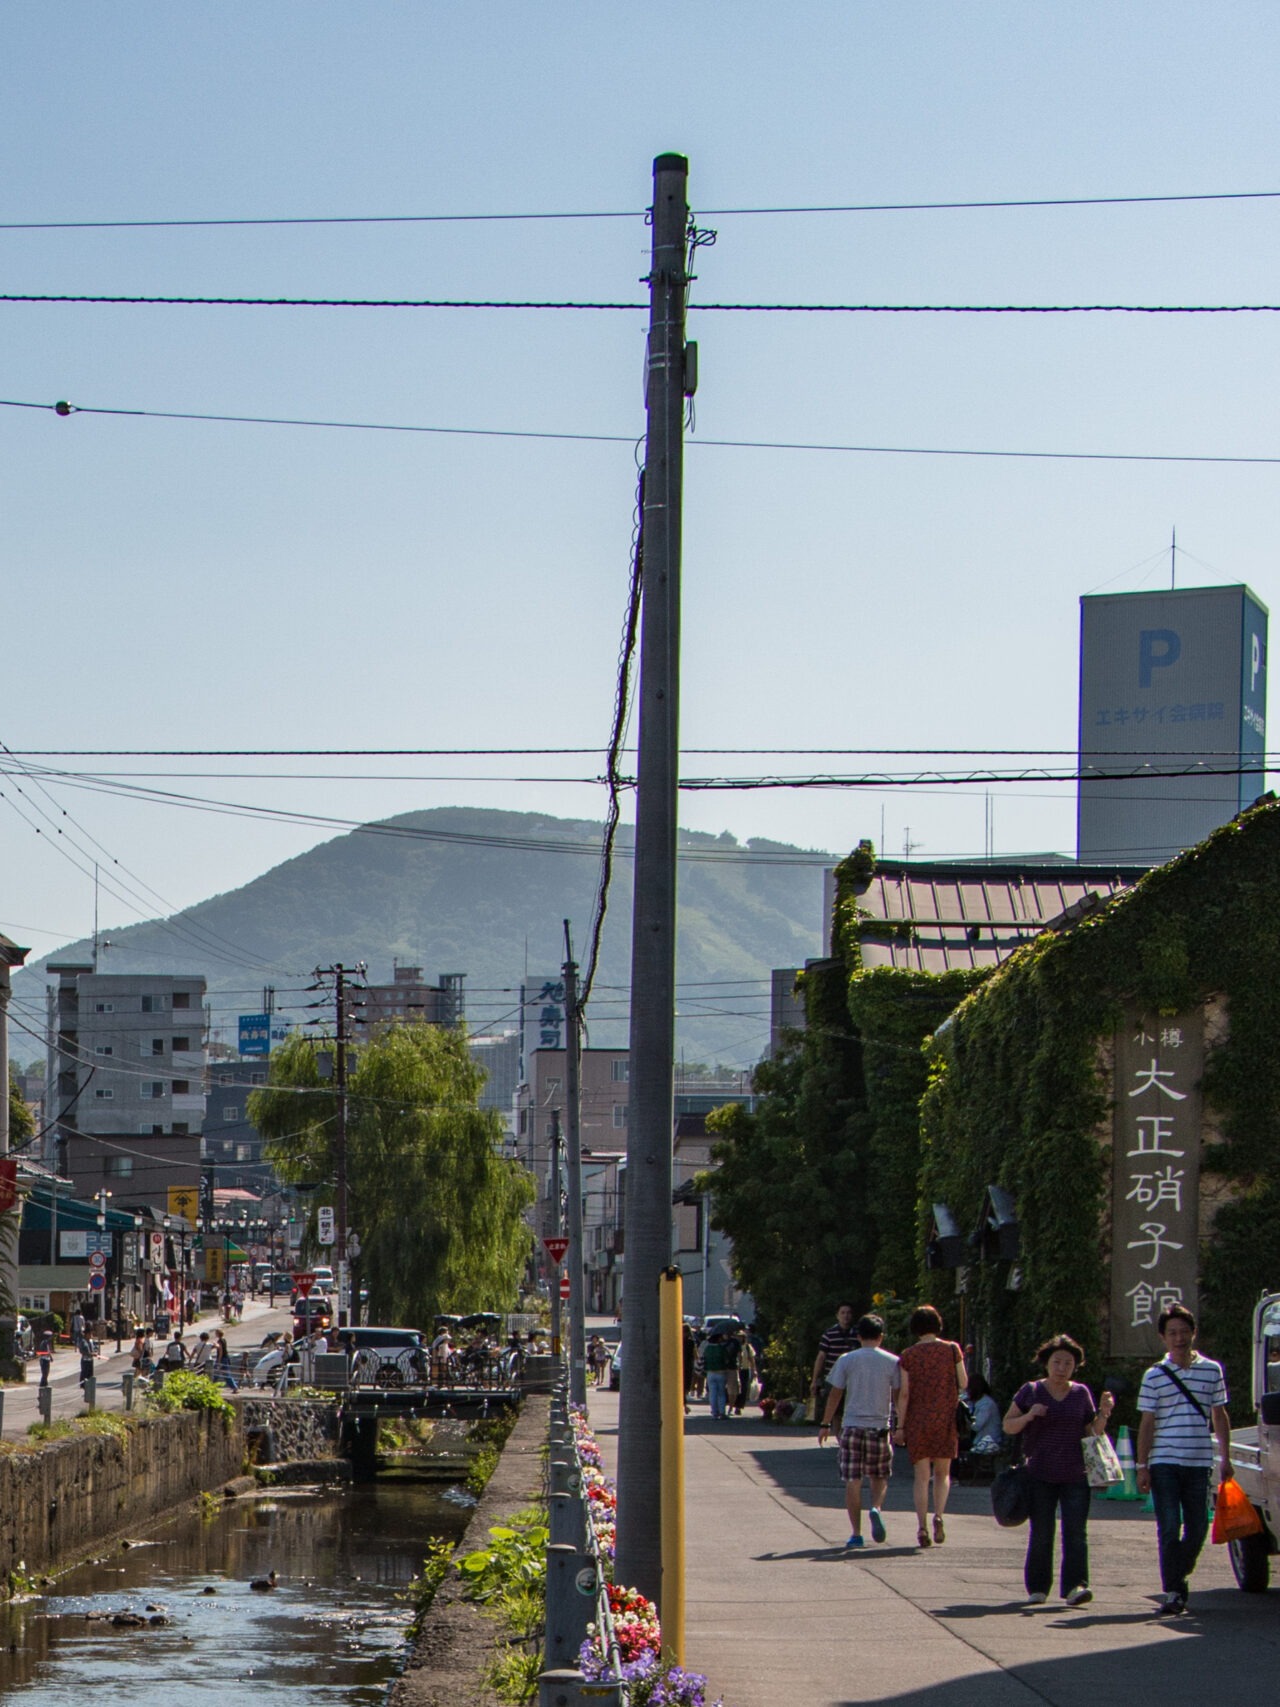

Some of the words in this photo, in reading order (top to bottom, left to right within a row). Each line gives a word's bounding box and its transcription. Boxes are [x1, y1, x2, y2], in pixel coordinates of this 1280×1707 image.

[1138, 628, 1181, 689] P
[1251, 632, 1260, 692] P
[1132, 1027, 1184, 1048] 小樽
[1125, 1058, 1188, 1327] 大正硝子館
